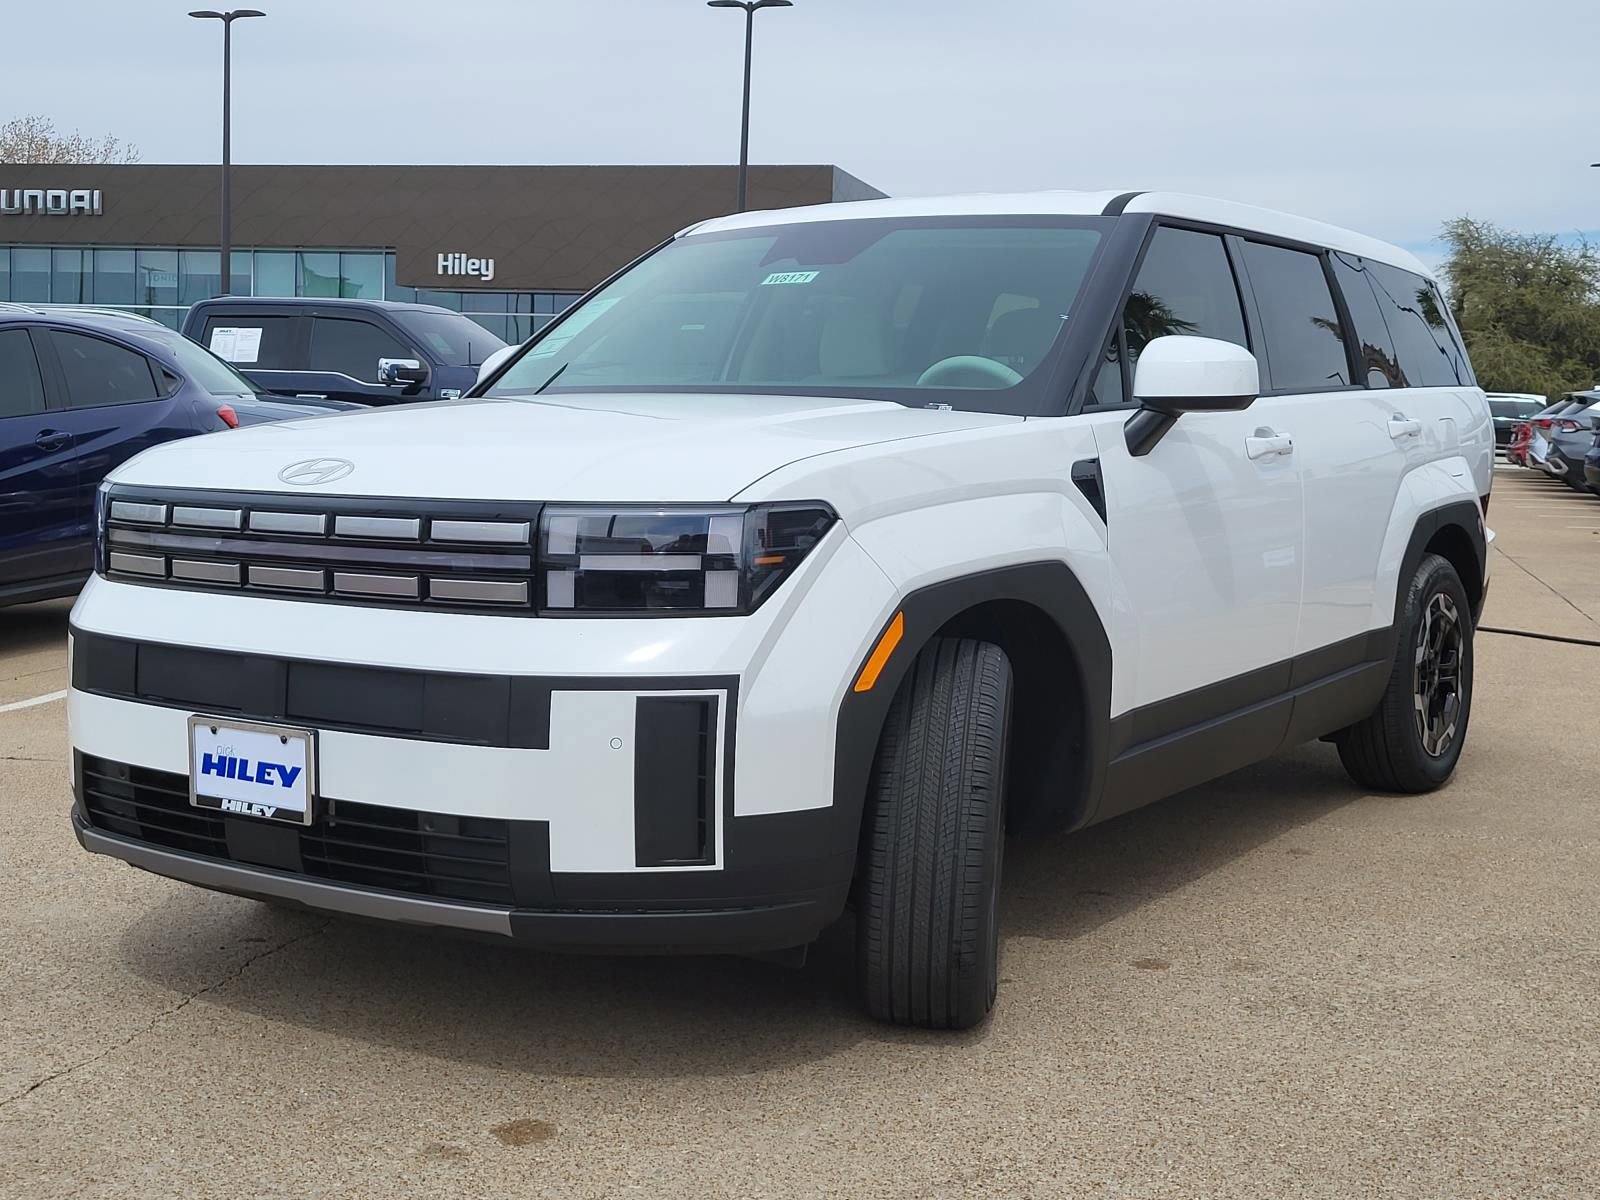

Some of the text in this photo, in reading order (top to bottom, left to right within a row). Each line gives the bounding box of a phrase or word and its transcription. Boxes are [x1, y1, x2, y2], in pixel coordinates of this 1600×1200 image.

[437, 253, 495, 281] Hiley
[202, 752, 302, 788] HILEY
[221, 798, 277, 817] HILEY
